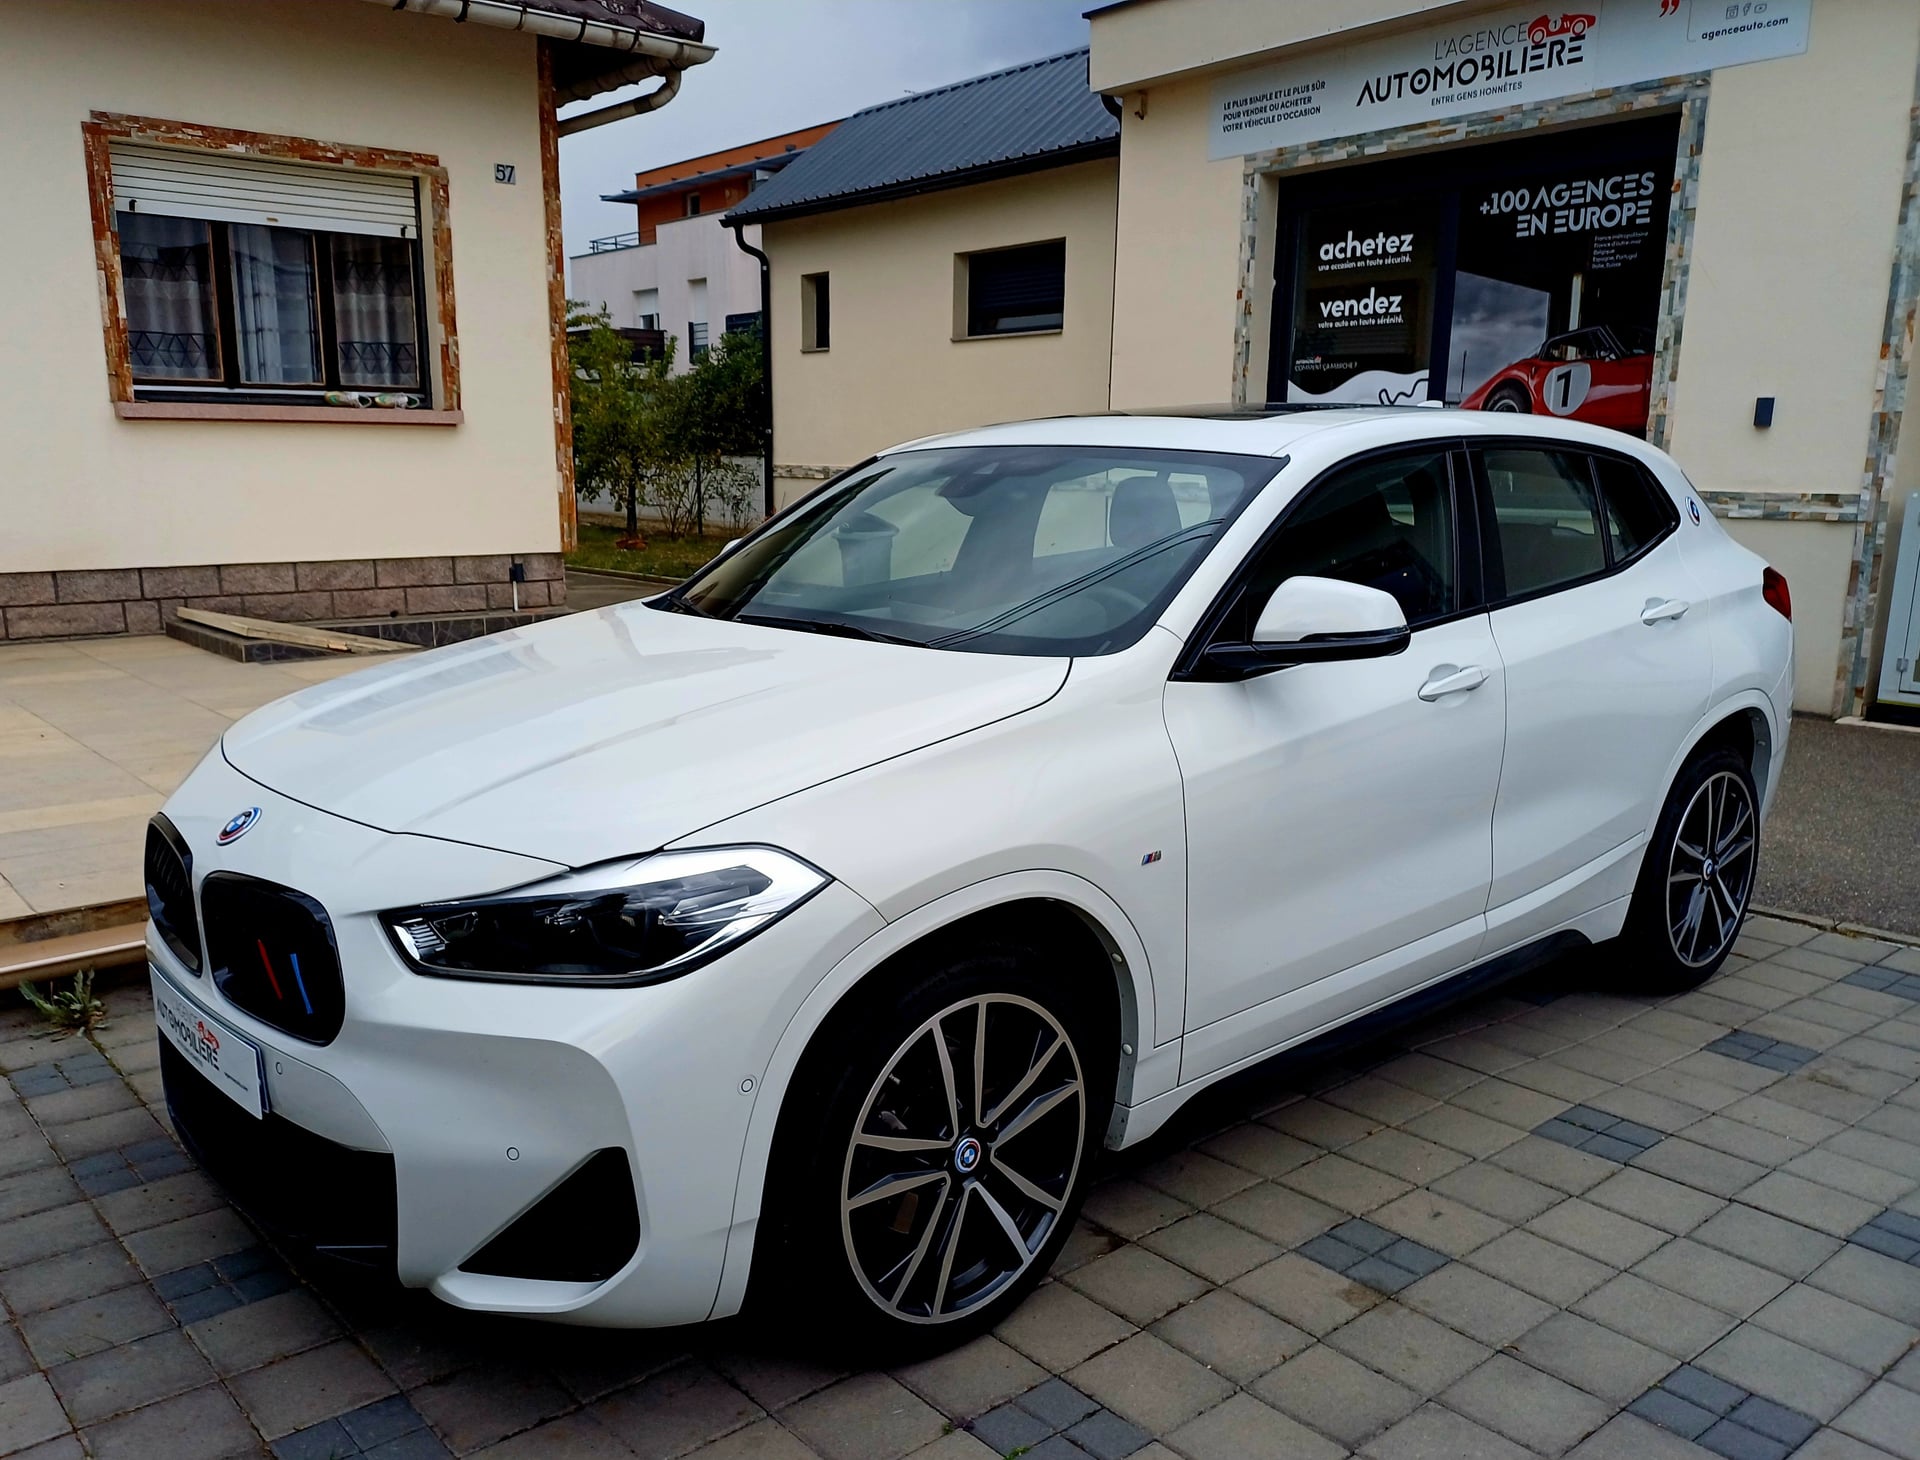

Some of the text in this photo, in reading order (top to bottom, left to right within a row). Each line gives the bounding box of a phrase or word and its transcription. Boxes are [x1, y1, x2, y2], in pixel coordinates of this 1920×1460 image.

[1434, 21, 1528, 61] L'AGENCE
[1702, 17, 1789, 41] agenceauto.com
[1223, 80, 1326, 111] LE PLUS SIMPLE ET LE PLUS SÛR
[1223, 96, 1312, 122] POUR VENDRE OU ACHETER
[1431, 81, 1523, 106] ENTRE GENS HONNÊTES
[1222, 106, 1321, 132] VOTRE VÉHICULE D'OCCASION
[495, 164, 515, 183] 57
[1480, 171, 1655, 215] +100 AGENCES
[1516, 200, 1652, 238] EN EUROPE
[1320, 230, 1414, 261] achetez
[1320, 287, 1402, 318] vendez
[1557, 369, 1572, 408] 1
